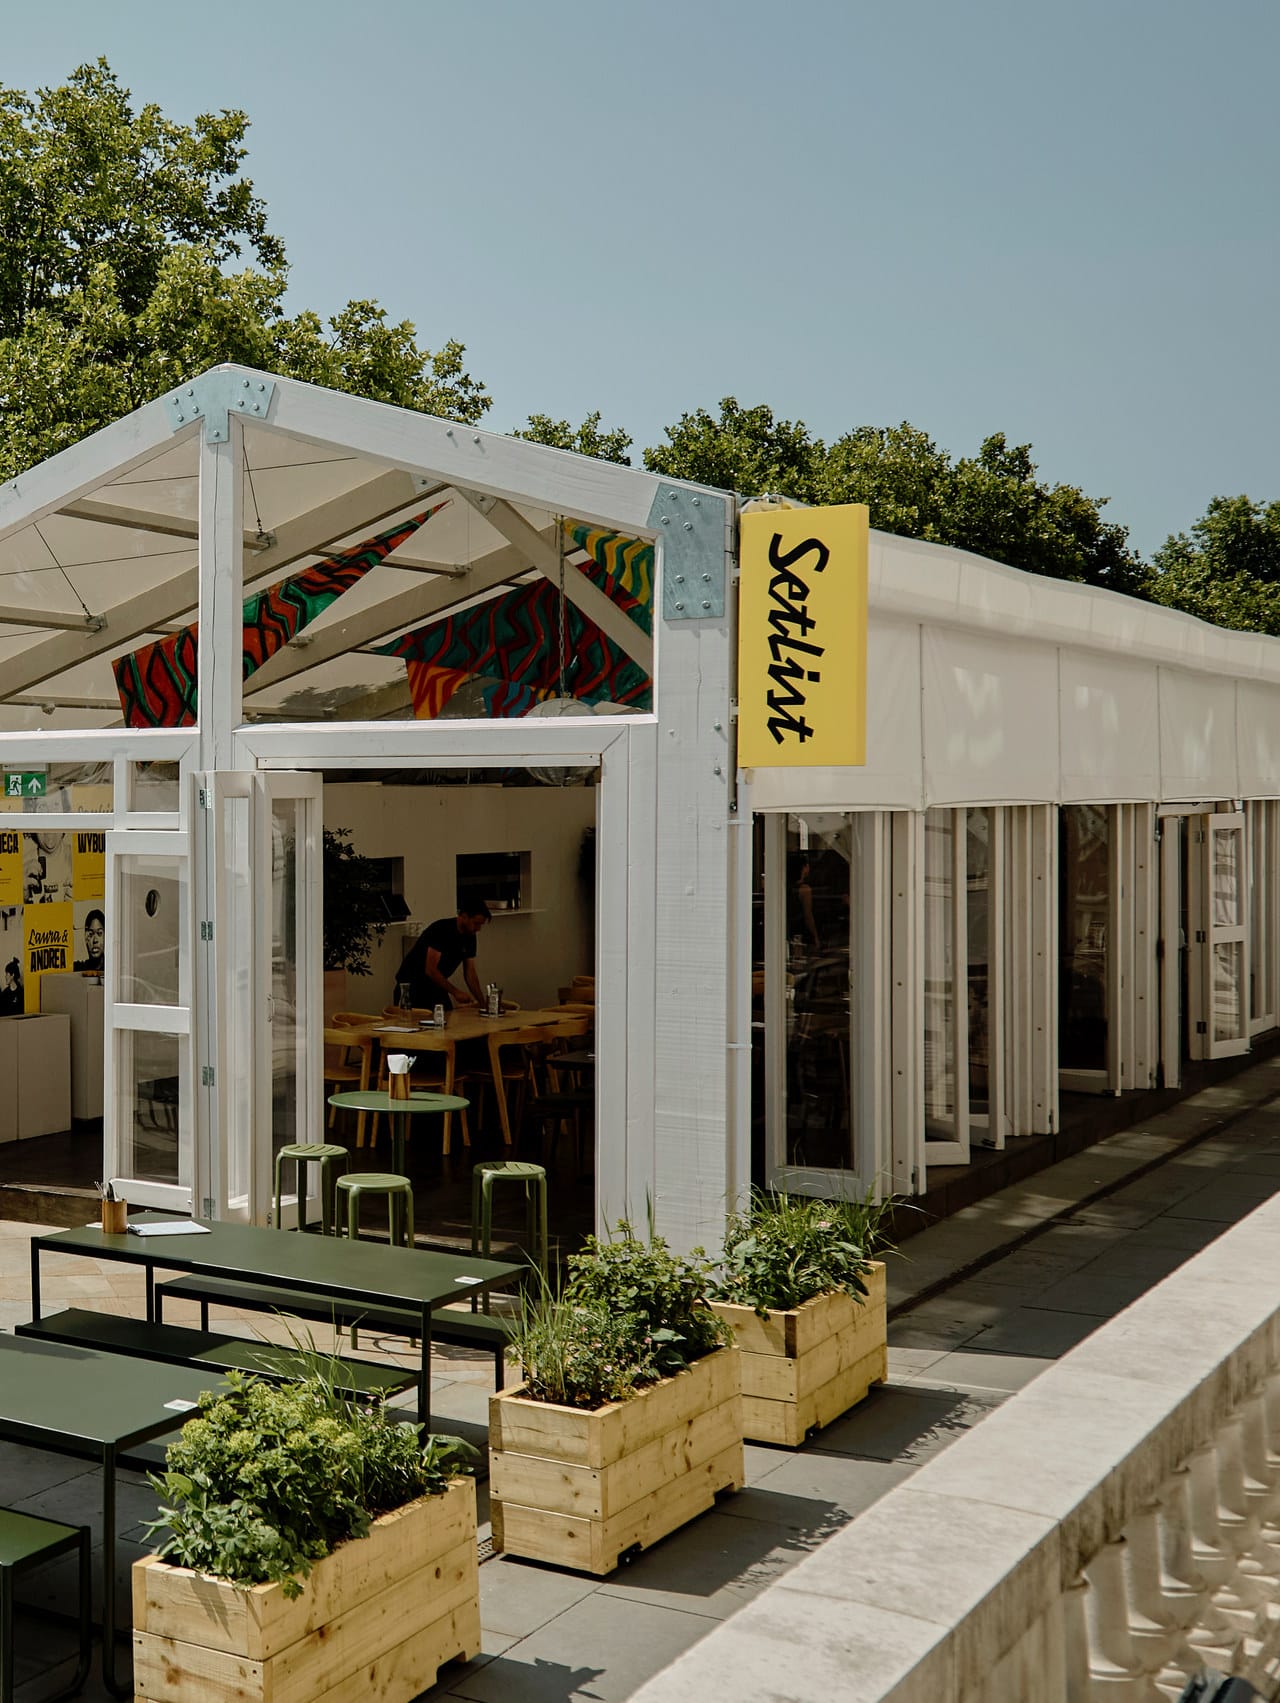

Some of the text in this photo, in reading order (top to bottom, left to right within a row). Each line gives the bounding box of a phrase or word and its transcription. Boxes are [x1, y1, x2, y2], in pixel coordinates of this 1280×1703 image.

[766, 533, 830, 744] Setlist
[77, 832, 106, 854] WYBU
[28, 929, 68, 946] Laura &
[30, 948, 67, 972] ANDREA
